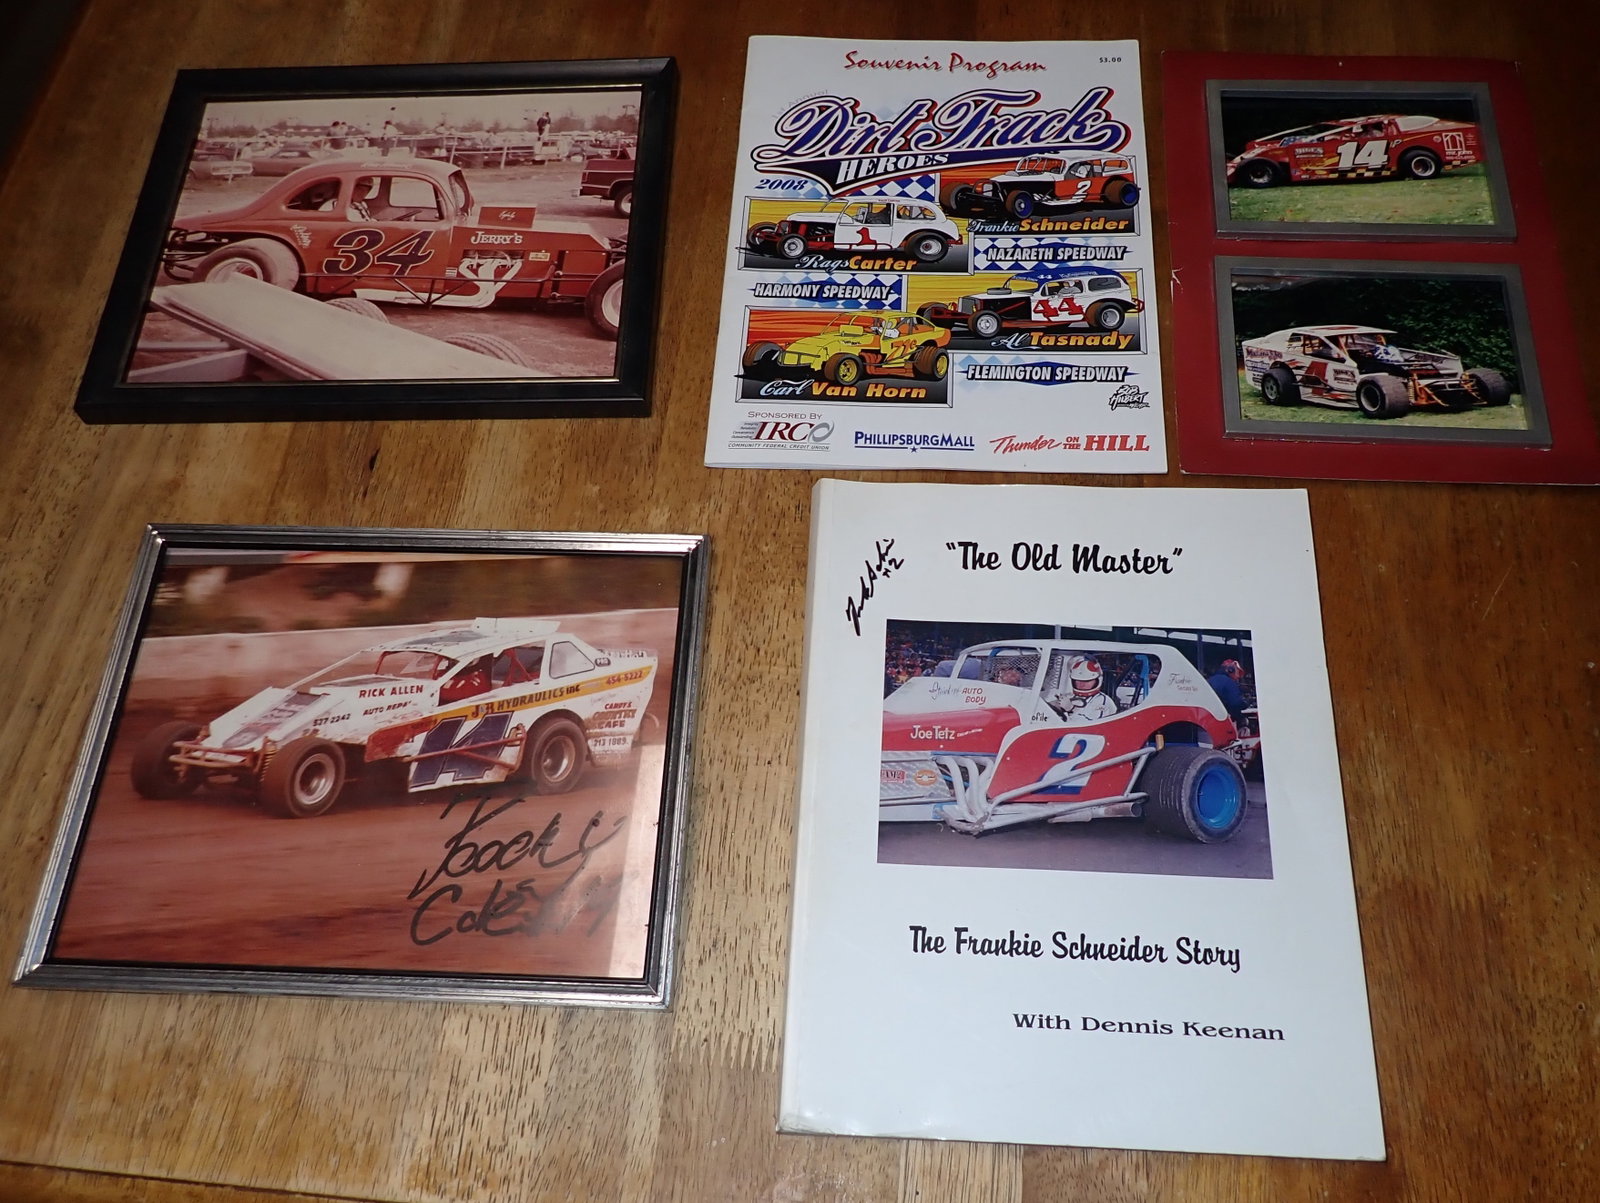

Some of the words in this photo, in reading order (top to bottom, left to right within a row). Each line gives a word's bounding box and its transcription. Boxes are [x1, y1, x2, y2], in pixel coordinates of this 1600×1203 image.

[844, 50, 941, 72] Souvenir
[948, 52, 1047, 78] Program
[1098, 56, 1123, 64] $3.00
[752, 93, 937, 159] Dirt
[910, 85, 1130, 158] Track
[1336, 139, 1389, 171] 14
[835, 153, 950, 185] HEROES
[754, 177, 807, 191] 2008
[1074, 180, 1092, 197] 2
[966, 219, 1020, 233] Frankie
[1019, 215, 1130, 232] Schneider
[470, 230, 524, 245] JERRY'S
[855, 228, 876, 245] 1
[323, 228, 436, 278] 34
[987, 247, 1054, 261] NAZARETH
[1056, 247, 1126, 260] SPEEDWAY
[795, 253, 850, 273] Rags
[848, 255, 917, 271] Carter
[753, 282, 820, 298] HARMONY
[822, 284, 891, 301] SPEEDWAY
[1032, 297, 1086, 318] 44
[991, 334, 1024, 351] Al
[1029, 332, 1135, 350] Tasnady
[967, 365, 1052, 381] FLEMINGTON
[1054, 366, 1128, 381] SPEEDWAY
[759, 377, 814, 398] Carl
[811, 383, 860, 398] Van
[865, 384, 927, 399] Horn
[747, 410, 807, 420] SPONSORED
[990, 434, 1062, 455] Thunder
[1062, 443, 1082, 451] THE
[1066, 436, 1081, 444] ON
[1083, 434, 1150, 452] HILL
[1011, 542, 1062, 572] Old
[358, 687, 386, 699] RICK
[390, 684, 424, 696] ALLEN
[496, 688, 564, 712] HYDRAULICS
[961, 687, 983, 695] AUTO
[965, 696, 987, 706] BODY
[363, 706, 385, 716] AUTO
[910, 725, 933, 740] Joe
[932, 725, 956, 740] Tetz
[1031, 732, 1106, 796] 2
[909, 925, 946, 954] The
[954, 926, 1044, 958] Frankie
[1051, 930, 1168, 964] Schneider
[1175, 936, 1241, 973] Story
[1012, 1012, 1071, 1031] With
[1081, 1015, 1174, 1035] Dennis
[1182, 1020, 1285, 1041] Keenan
